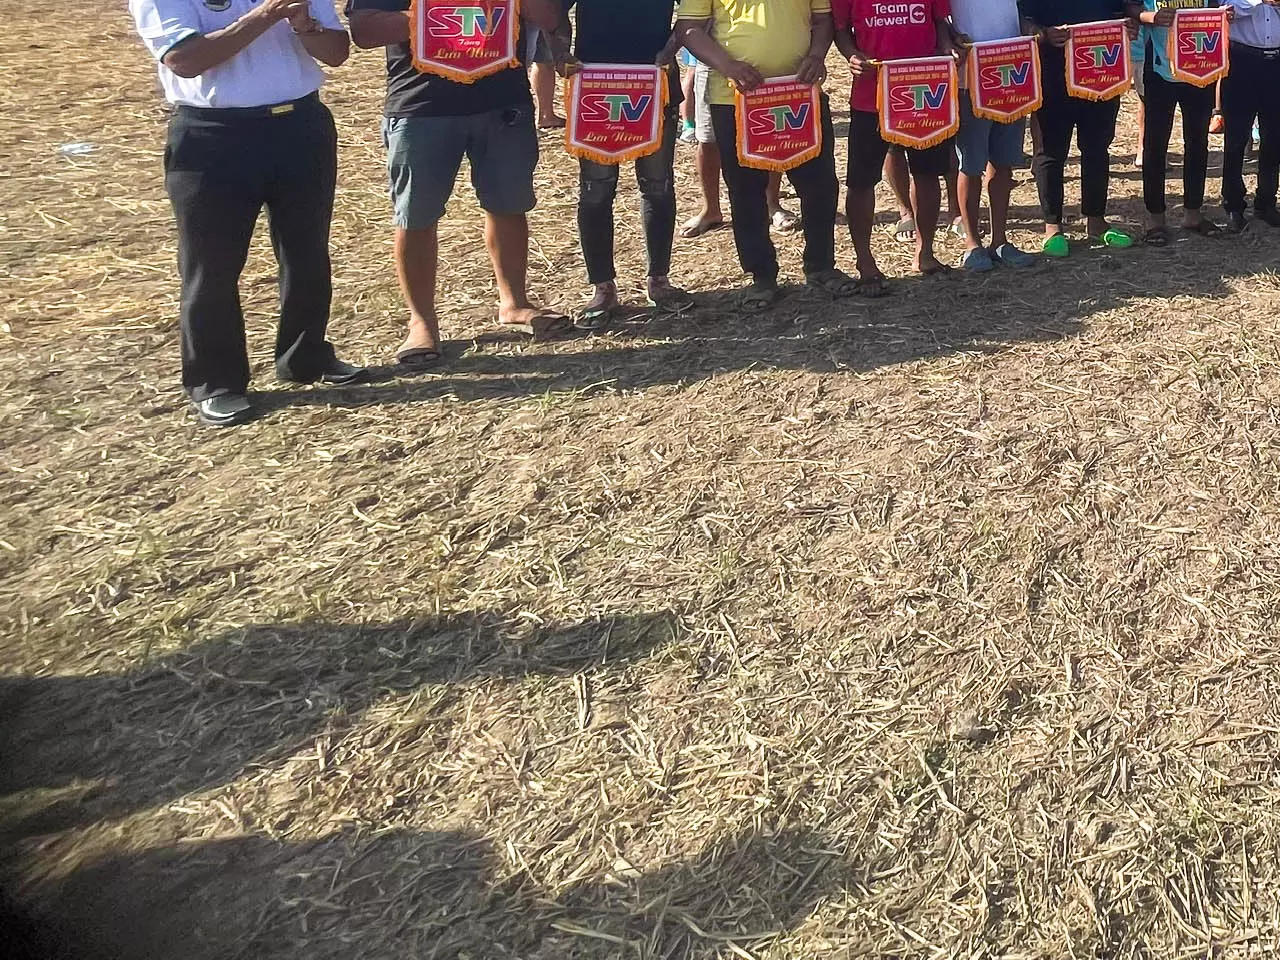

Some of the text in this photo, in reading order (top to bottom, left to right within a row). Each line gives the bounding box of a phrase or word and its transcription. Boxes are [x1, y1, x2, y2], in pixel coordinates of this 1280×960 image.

[427, 6, 506, 37] STV
[864, 16, 909, 28] Viewer
[871, 2, 908, 15] Team
[1074, 43, 1121, 70] STV
[1179, 31, 1220, 54] STV
[980, 61, 1031, 90] STV
[580, 93, 653, 122] STV
[890, 83, 948, 112] STV
[748, 102, 811, 136] STV
